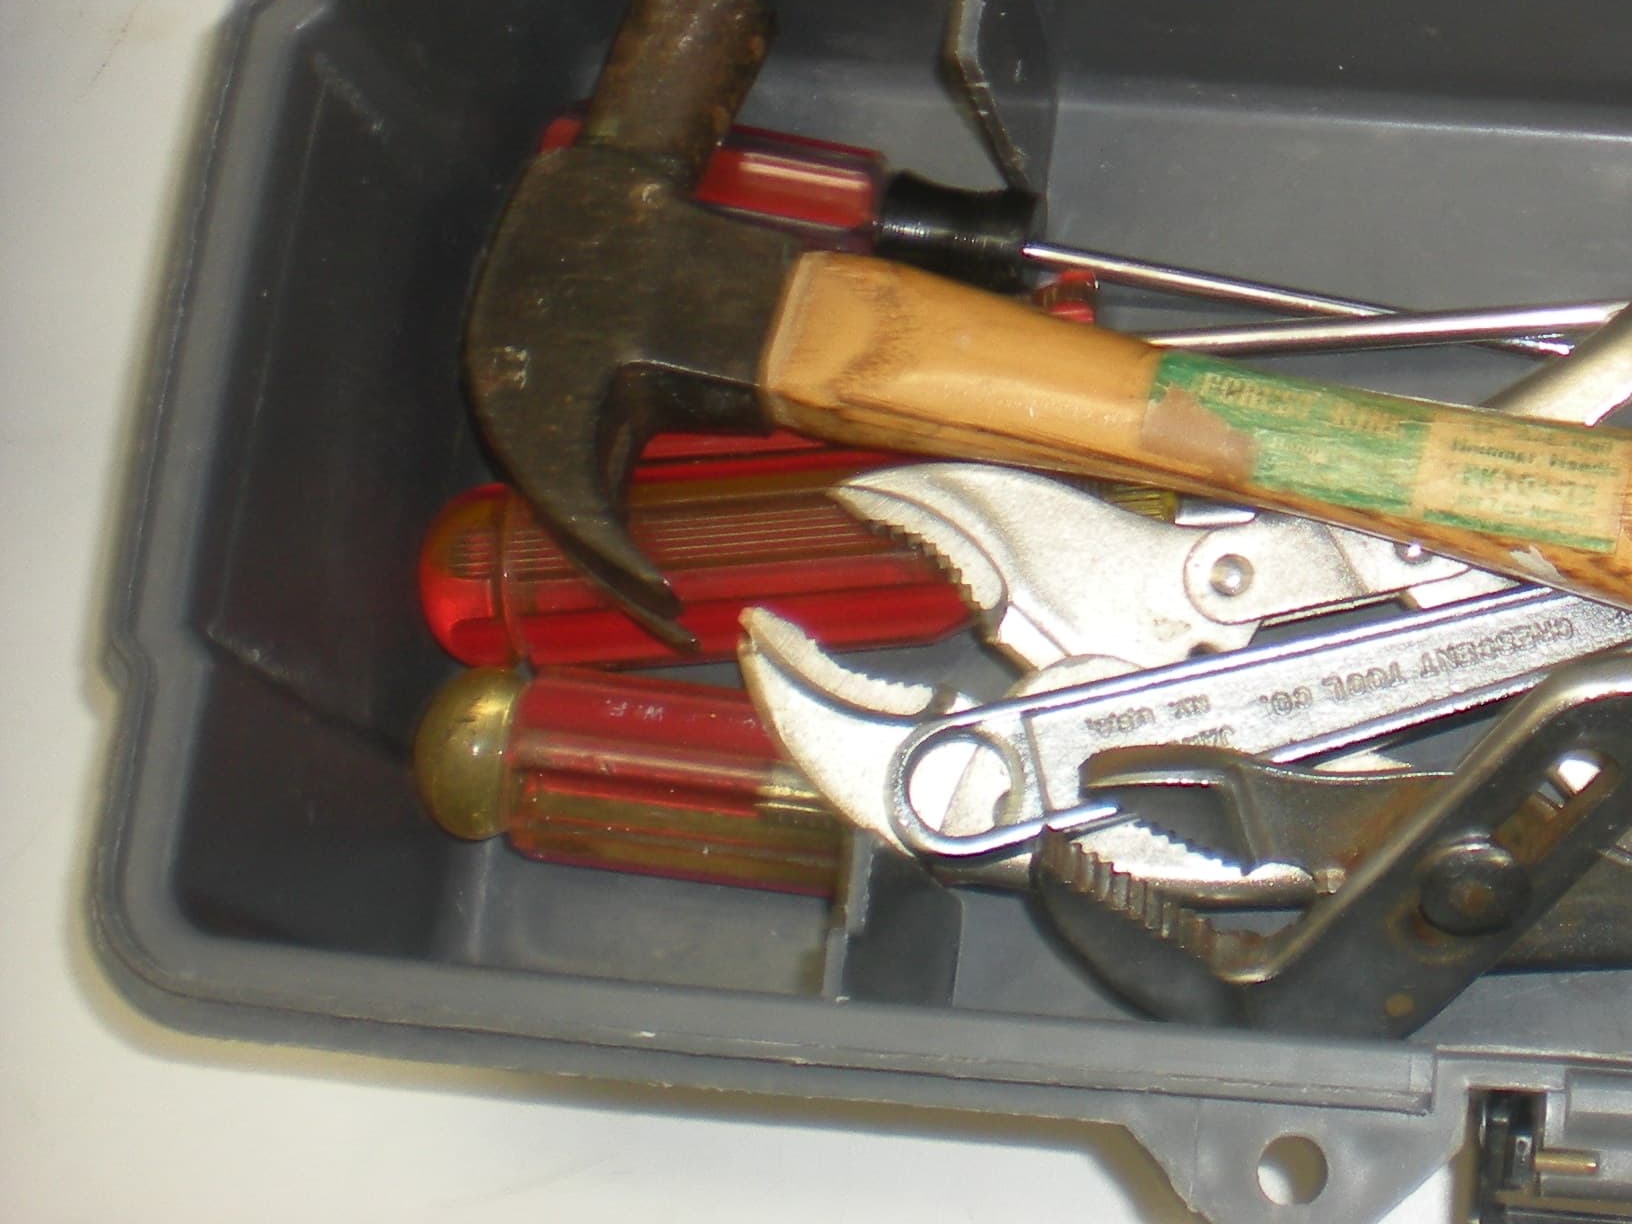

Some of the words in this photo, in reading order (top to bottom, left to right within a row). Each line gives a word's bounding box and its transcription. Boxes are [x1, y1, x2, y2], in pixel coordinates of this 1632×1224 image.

[1419, 616, 1575, 679] CRESCENT
[1258, 684, 1314, 717] CO.
[1320, 661, 1408, 702] TOOL
